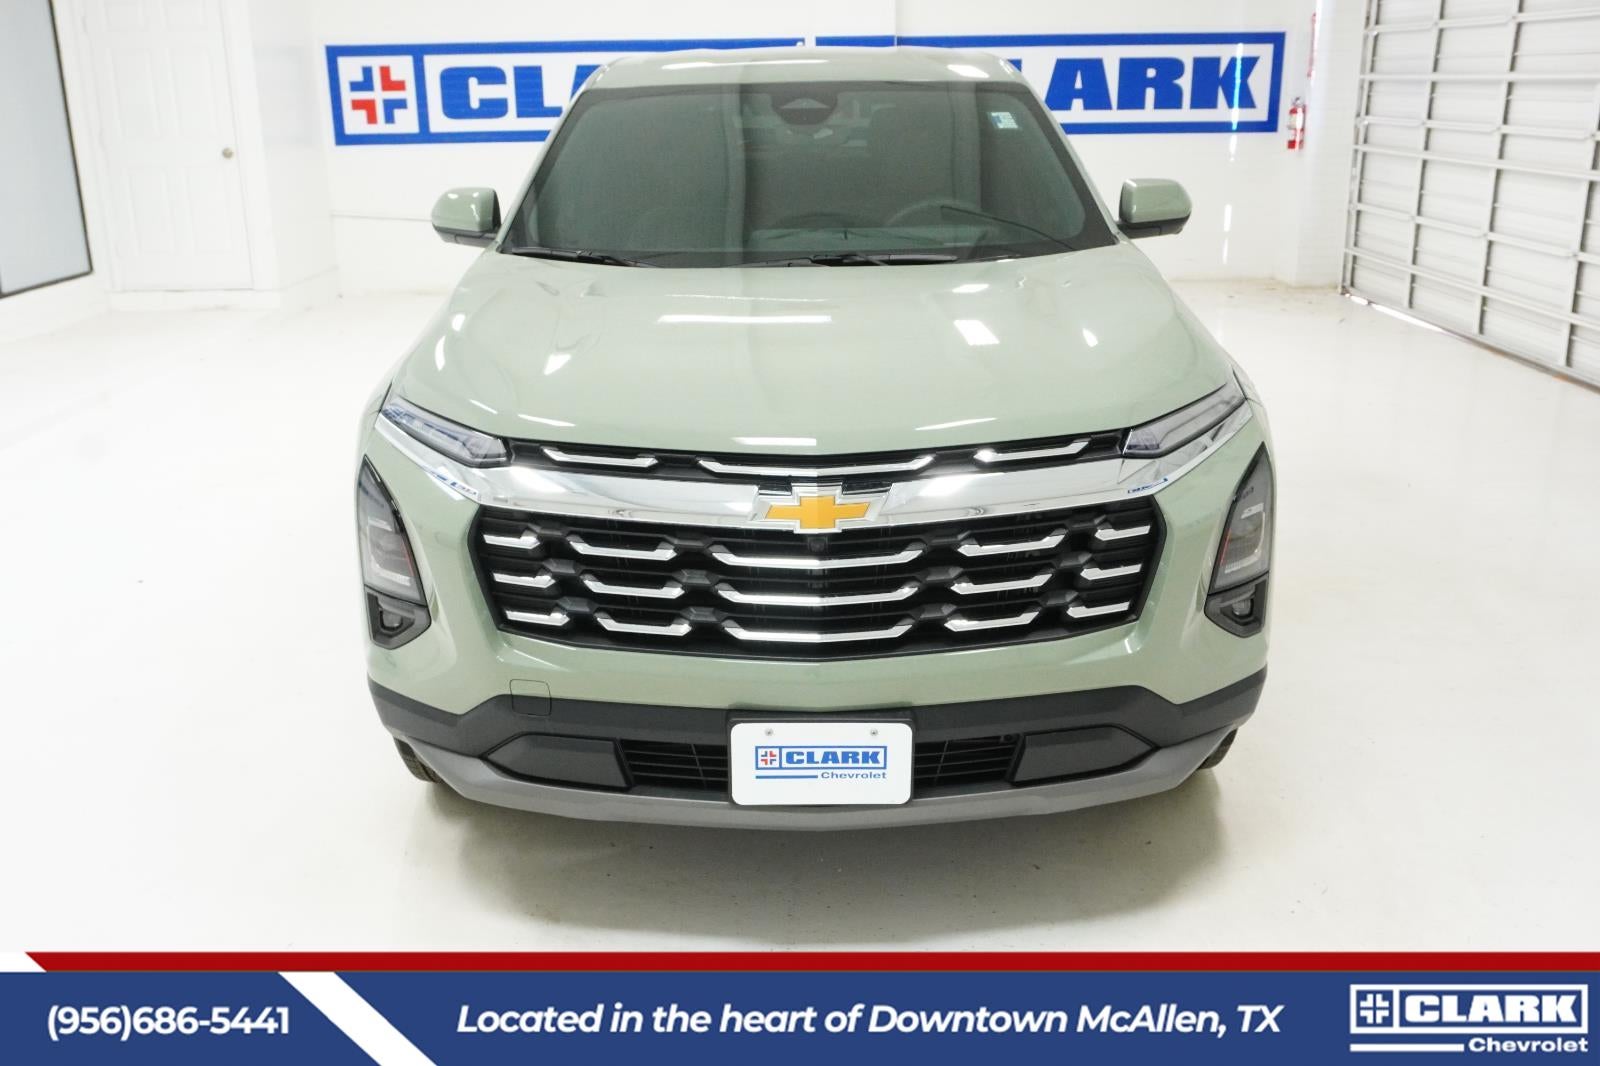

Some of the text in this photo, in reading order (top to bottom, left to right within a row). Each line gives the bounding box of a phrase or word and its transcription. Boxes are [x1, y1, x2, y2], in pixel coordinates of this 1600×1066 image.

[1006, 56, 1260, 114] ARK
[785, 751, 881, 765] CLARK
[821, 771, 887, 779] Chevrolet
